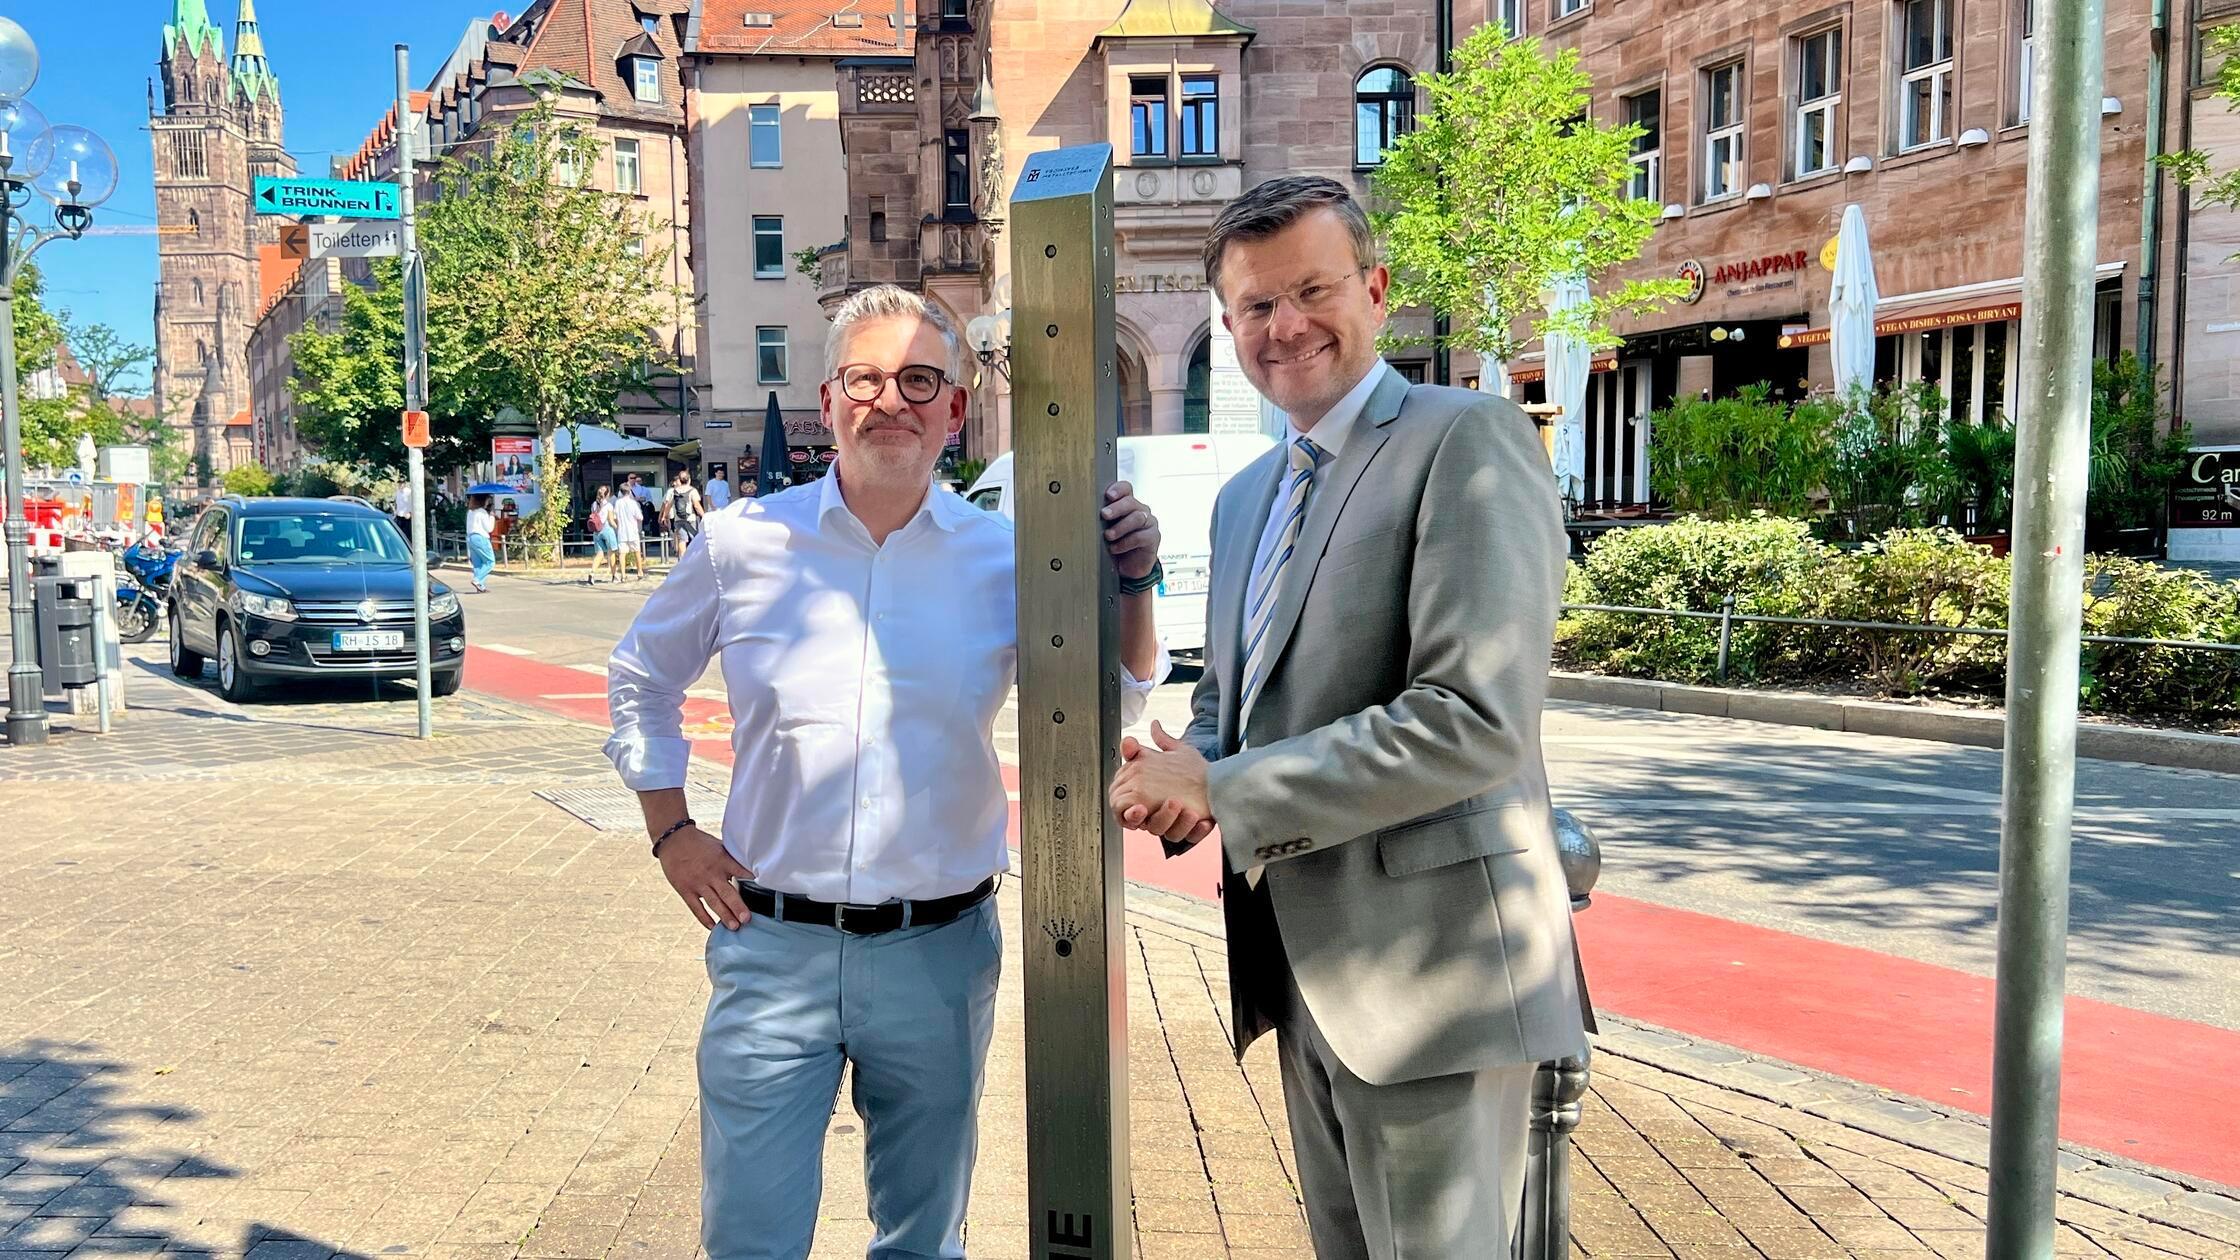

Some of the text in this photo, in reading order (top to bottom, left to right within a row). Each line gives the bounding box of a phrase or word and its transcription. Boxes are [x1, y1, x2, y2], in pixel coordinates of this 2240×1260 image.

[281, 186, 341, 197] TRINK-
[281, 197, 370, 210] BRUNNEN
[313, 232, 381, 249] Toiletten
[1714, 250, 1808, 285] ANJAPPAR
[1880, 321, 1908, 333] VEGAN
[1909, 317, 1941, 330] DISHES
[1947, 313, 1971, 324] DOSA
[1977, 306, 2017, 319] BIRYANI
[809, 449, 820, 464] &
[2202, 509, 2232, 520] 92 m
[342, 635, 357, 646] RH
[385, 635, 398, 646] 18
